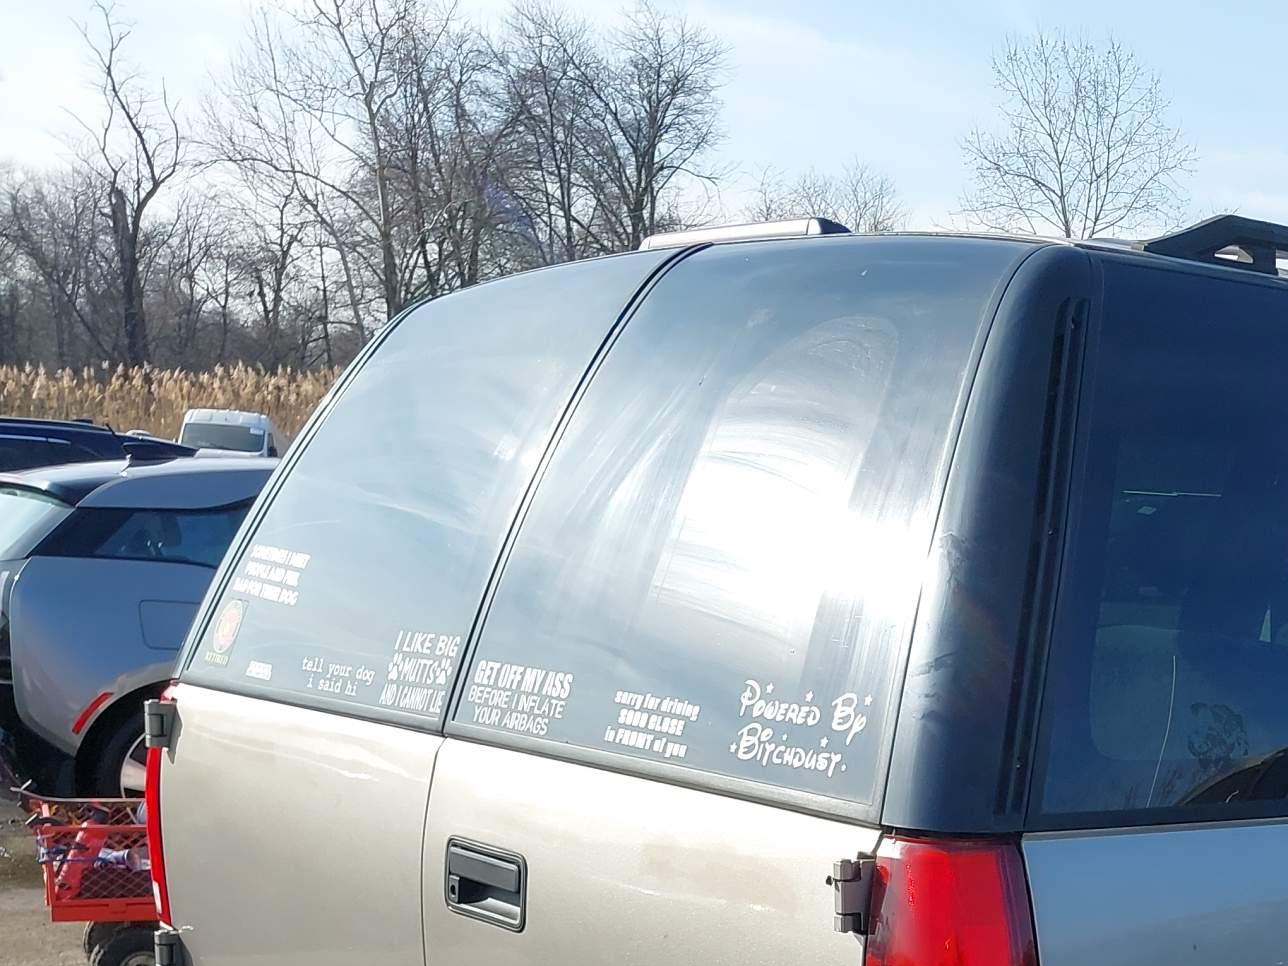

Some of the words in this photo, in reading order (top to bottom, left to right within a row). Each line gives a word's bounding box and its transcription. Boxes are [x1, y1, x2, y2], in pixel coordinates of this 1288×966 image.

[394, 630, 403, 650] I
[402, 631, 436, 654] LIKE
[435, 635, 461, 658] BIG
[302, 657, 323, 673] tell
[327, 662, 352, 678] your
[356, 664, 375, 685] dog
[400, 657, 439, 685] MUTTS
[474, 660, 501, 687] GET
[498, 663, 524, 690] OFF
[520, 668, 547, 694] MY
[545, 672, 573, 699] ASS
[318, 677, 342, 692] said
[345, 682, 357, 696] hi
[379, 682, 397, 705] AND
[400, 685, 434, 712] CANNOT
[429, 690, 446, 713] LIE
[467, 685, 511, 709] BEFORE
[511, 691, 518, 711] I
[517, 692, 566, 719] INFLATE
[614, 691, 644, 709] sorry
[643, 693, 660, 710] for
[660, 697, 700, 721] driving
[473, 705, 501, 726] YOUR
[501, 710, 549, 736] AIRBAGS
[647, 714, 685, 736] CLOSE
[604, 726, 616, 742] in
[615, 728, 654, 750] FRONT
[653, 738, 667, 753] of
[664, 742, 688, 758] you
